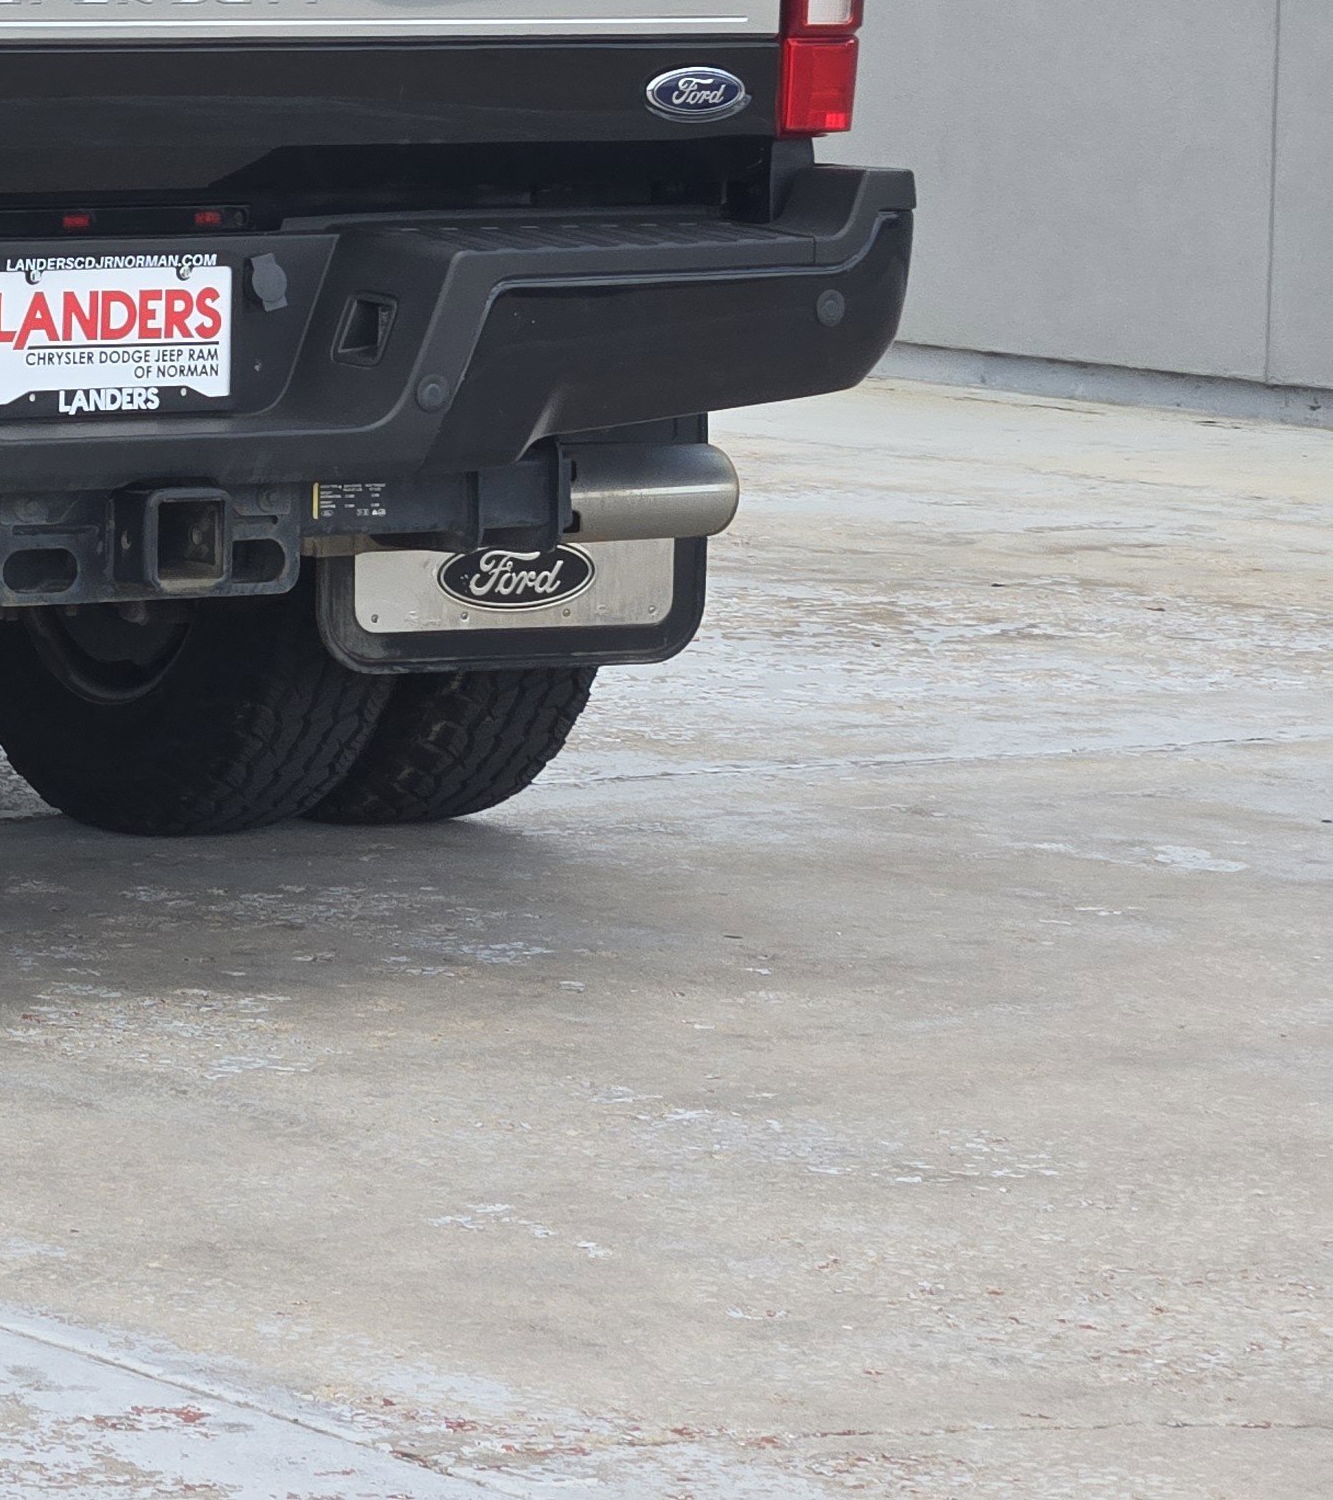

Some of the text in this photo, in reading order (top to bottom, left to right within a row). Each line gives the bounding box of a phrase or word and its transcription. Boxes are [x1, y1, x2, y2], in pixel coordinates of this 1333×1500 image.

[671, 77, 726, 104] Ford
[6, 253, 218, 272] LANDERSCDJRNORMAN.COM
[25, 348, 219, 366] CHRYSLER DODGE JEEP RAM
[134, 364, 220, 379] OF NORMAN
[58, 386, 160, 415] LANDERS
[468, 549, 564, 596] Ford
